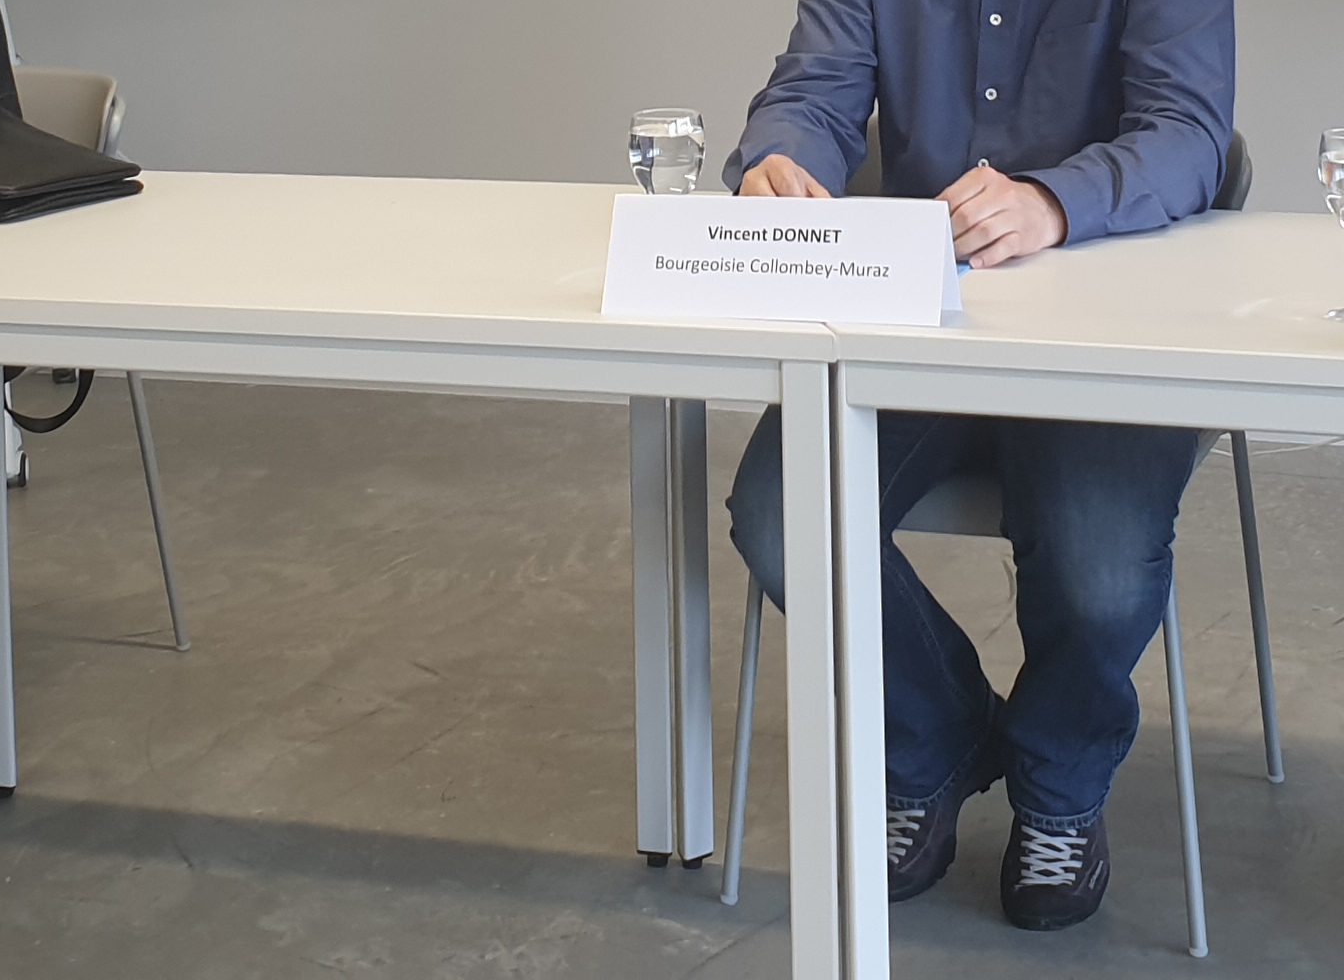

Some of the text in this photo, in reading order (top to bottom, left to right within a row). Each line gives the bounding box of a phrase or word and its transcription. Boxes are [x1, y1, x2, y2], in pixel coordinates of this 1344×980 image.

[707, 226, 842, 244] Vincent DONNET
[655, 255, 890, 279] Bourgeoisie Collombey-Muraz
